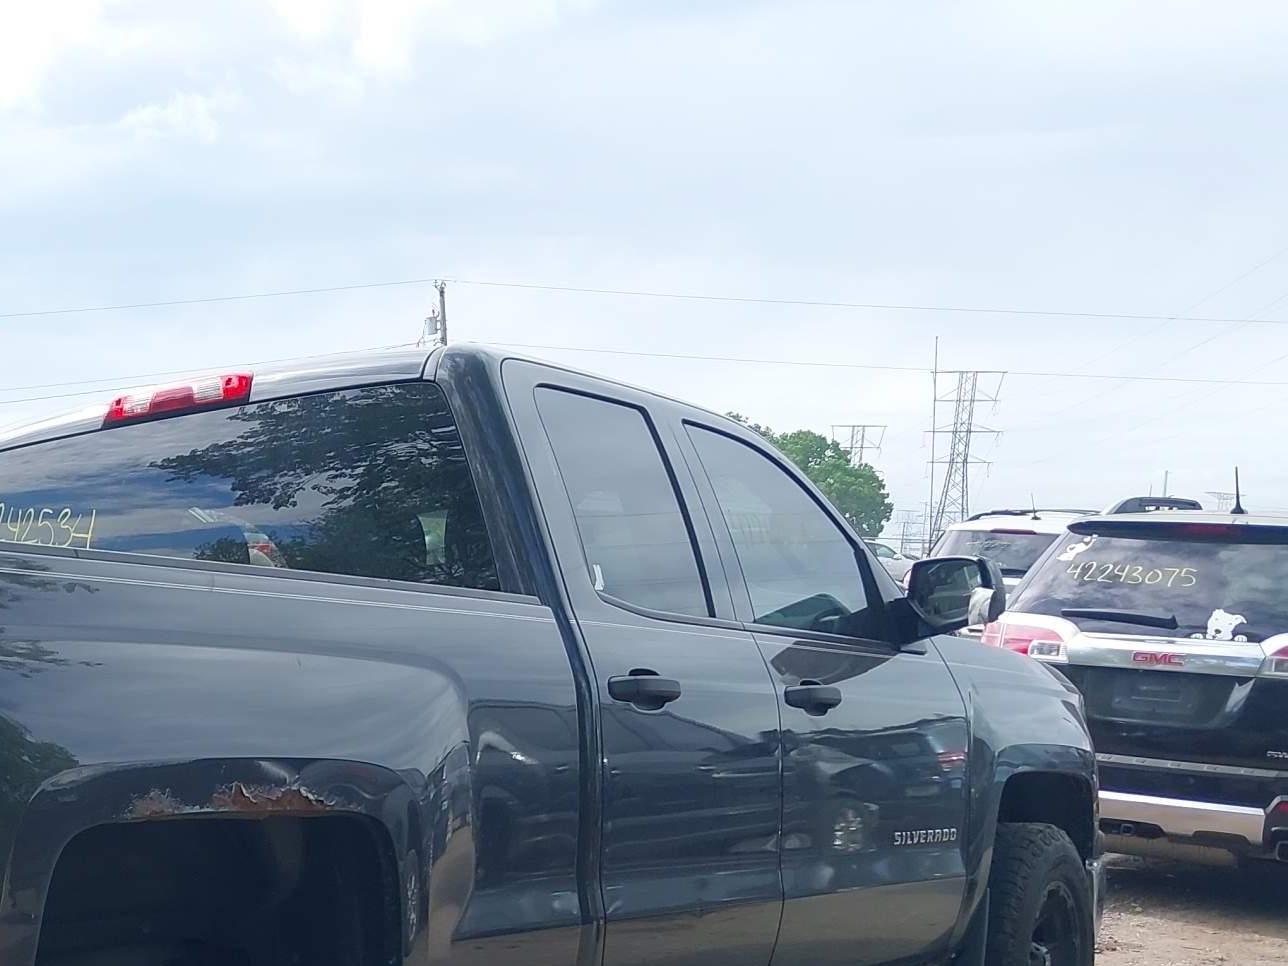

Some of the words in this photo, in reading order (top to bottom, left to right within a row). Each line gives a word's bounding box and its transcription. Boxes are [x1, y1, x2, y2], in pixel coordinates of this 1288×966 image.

[1066, 561, 1198, 587] 42243075
[1132, 651, 1186, 667] GMC
[893, 828, 958, 846] SILVERADO
